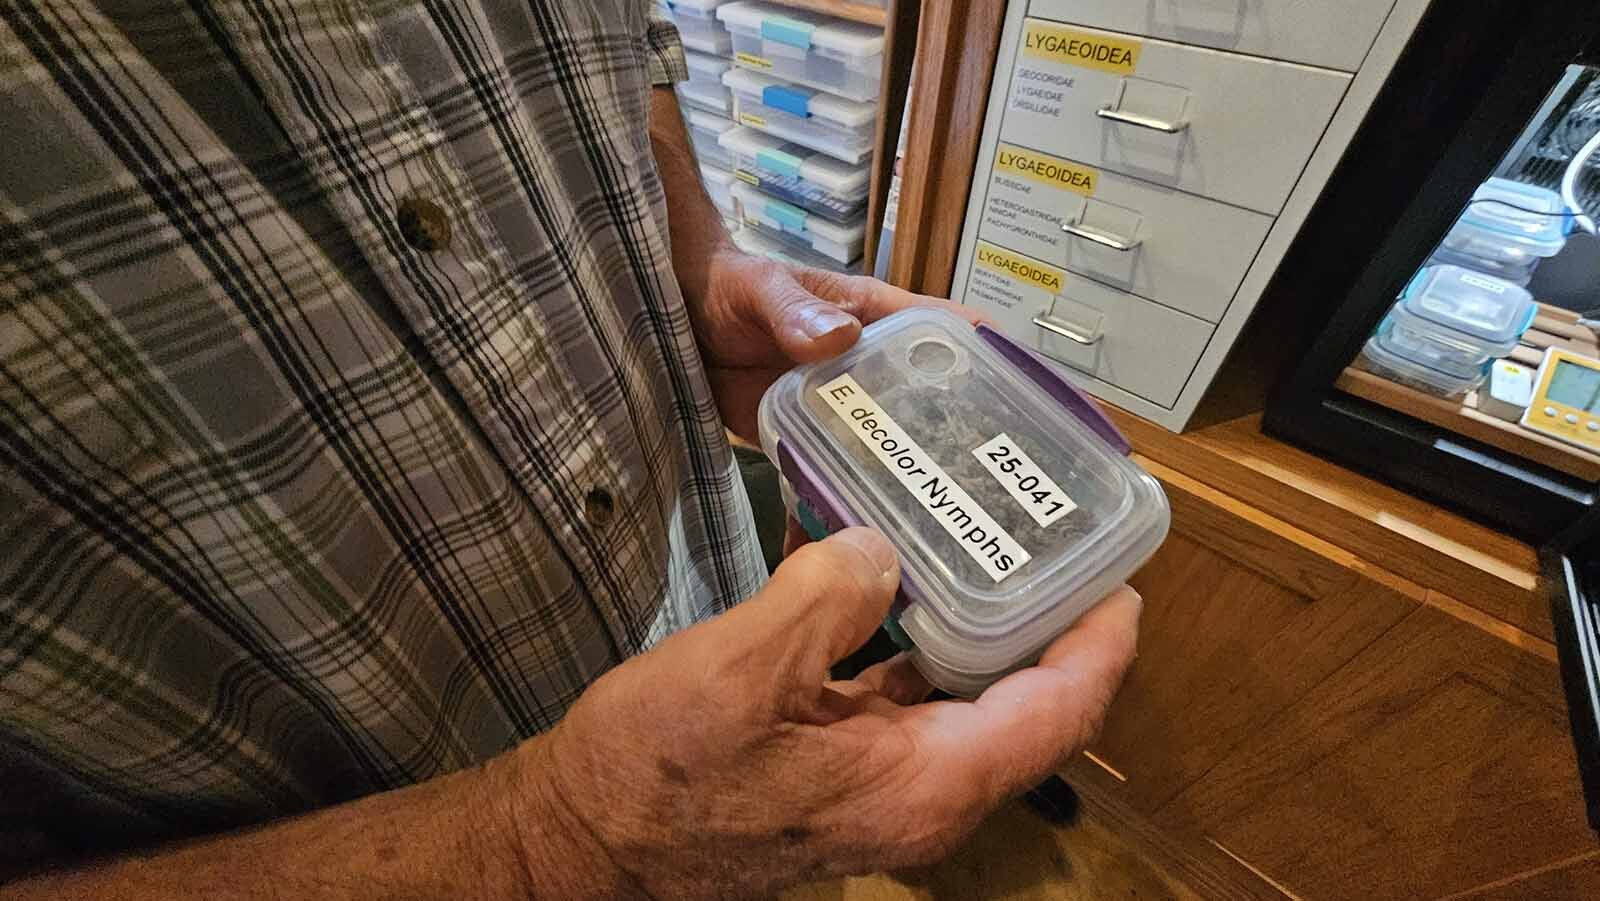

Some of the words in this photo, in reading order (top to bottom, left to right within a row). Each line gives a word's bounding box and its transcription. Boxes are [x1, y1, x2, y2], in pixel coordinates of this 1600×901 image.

[1025, 31, 1133, 67] LYGAEOIDEA
[999, 151, 1091, 189] LYGAEOIDEA
[978, 250, 1059, 289] LYGAEOIDEA
[830, 383, 856, 406] E.
[850, 406, 927, 478] decolor
[921, 476, 1015, 572] Nymphs
[987, 445, 1065, 517] 25-041
